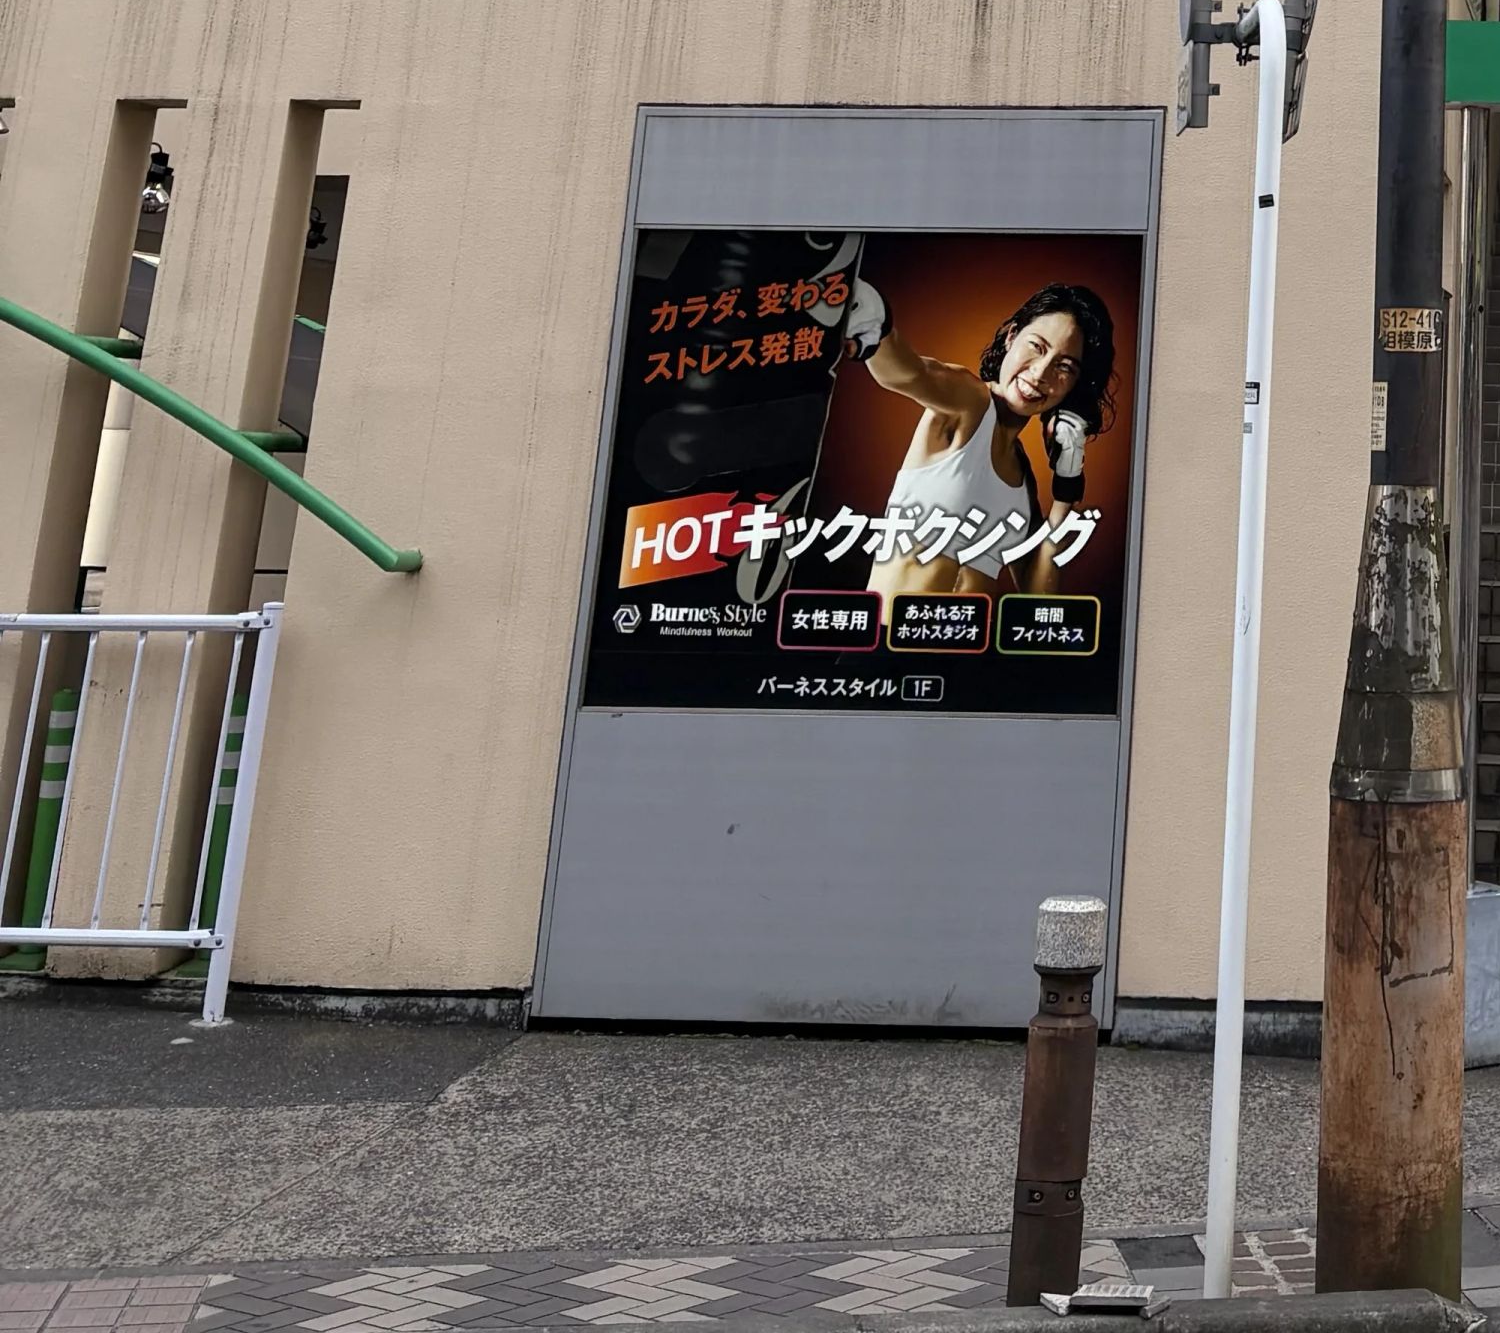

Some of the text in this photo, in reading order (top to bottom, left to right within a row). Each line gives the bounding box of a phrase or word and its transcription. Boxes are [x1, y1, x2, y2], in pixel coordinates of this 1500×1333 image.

[649, 273, 850, 333] カラダ、変わる
[644, 328, 825, 383] ストレス発散
[650, 603, 768, 627] Burnes Style
[791, 608, 869, 631] 女性専用
[904, 605, 976, 621] あふれる汗
[1034, 606, 1064, 624] 暗闇
[660, 626, 753, 637] Mindfulness Workout
[896, 624, 980, 641] ホットスタジオ
[1011, 626, 1086, 643] フィットネス
[757, 675, 932, 698] バーネススタイル 1F
